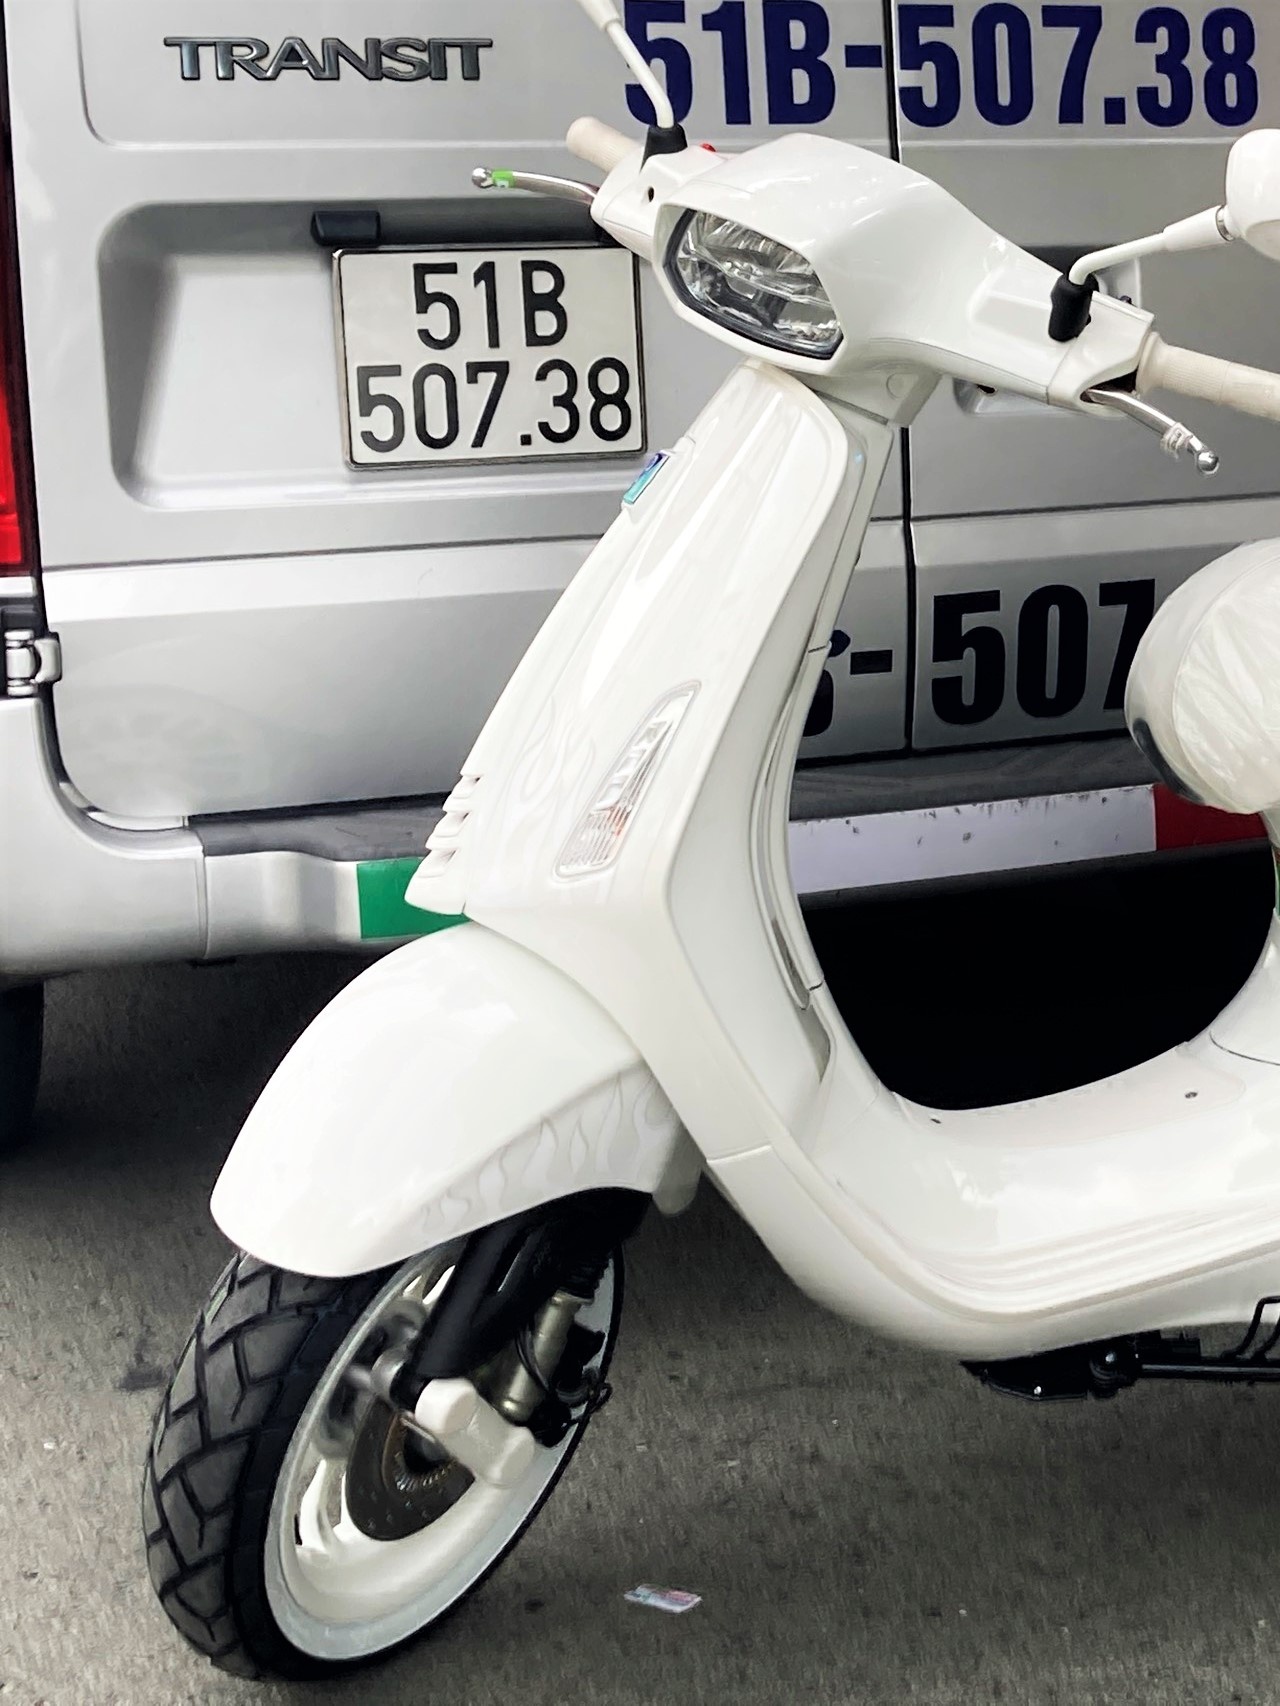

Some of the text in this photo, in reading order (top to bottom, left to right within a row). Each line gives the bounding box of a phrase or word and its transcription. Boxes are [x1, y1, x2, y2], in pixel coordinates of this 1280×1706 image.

[164, 37, 493, 81] TRANSIT
[624, 0, 1259, 128] 51B-507.38
[413, 259, 568, 350] 51B
[357, 357, 632, 453] 507.38
